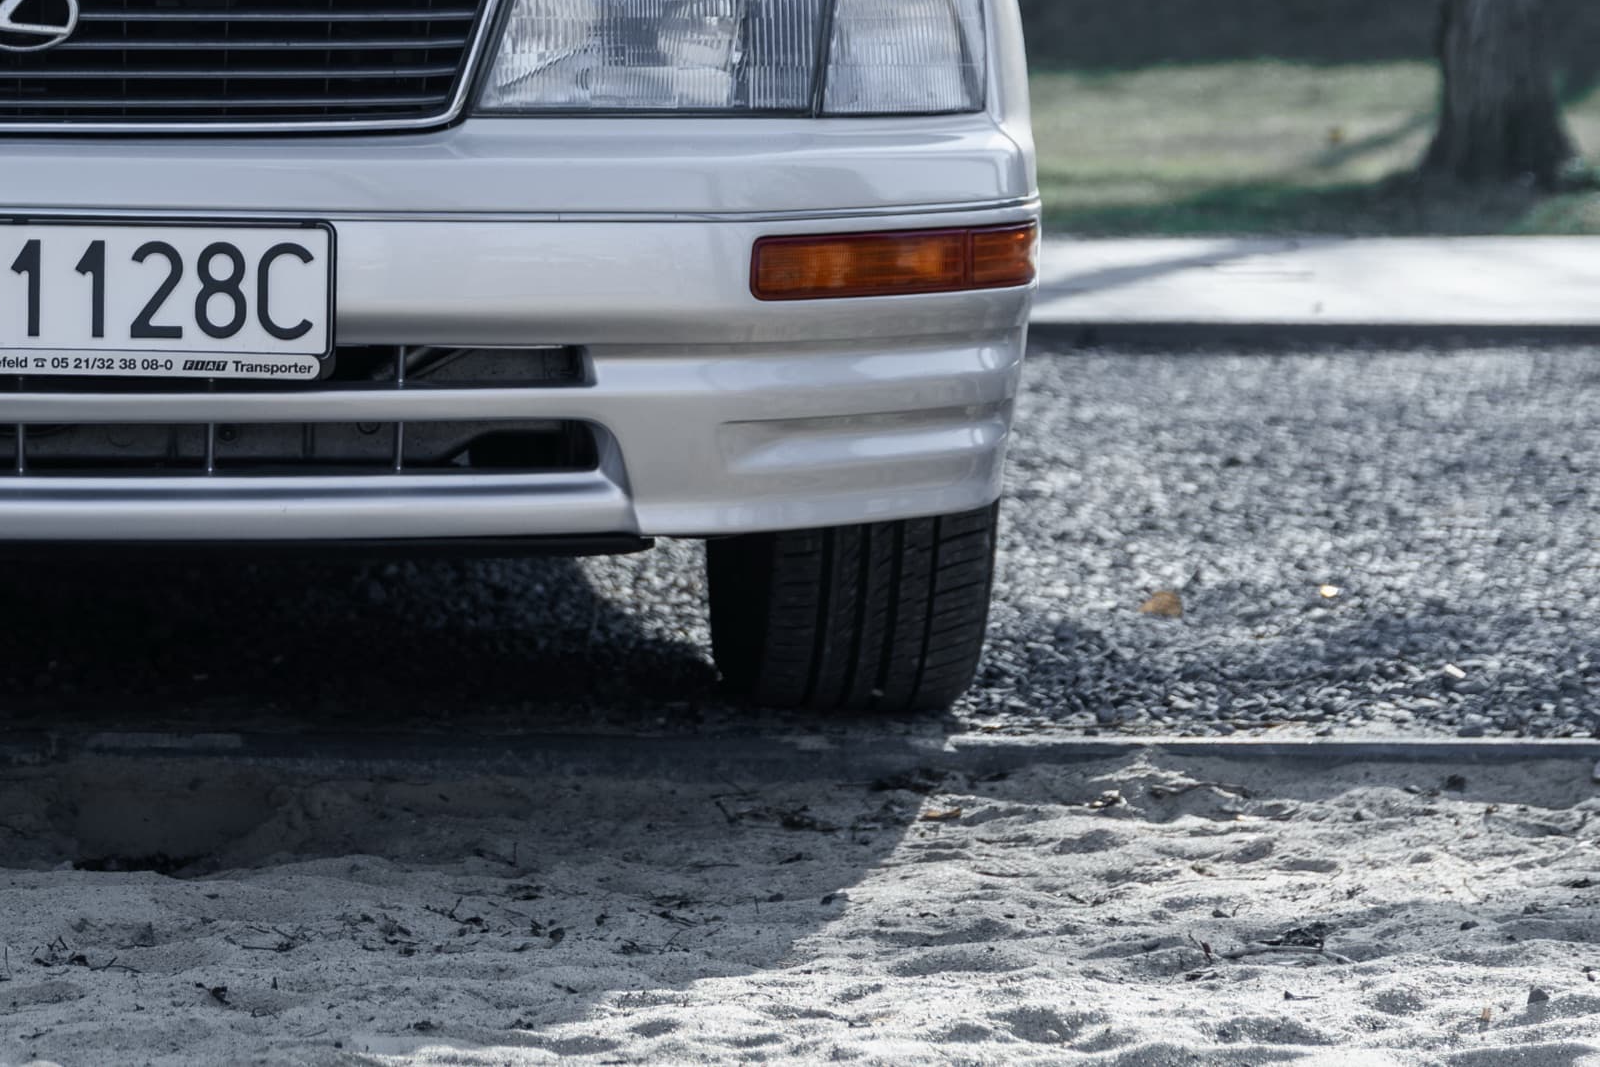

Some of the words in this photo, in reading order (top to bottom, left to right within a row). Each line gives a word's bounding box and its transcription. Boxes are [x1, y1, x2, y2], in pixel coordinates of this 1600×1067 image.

[10, 239, 315, 340] 1128C
[51, 357, 69, 369] 05
[73, 357, 115, 370] 21/32
[118, 358, 137, 370] 38
[141, 358, 174, 371] 08-0
[182, 359, 229, 372] FIAT
[232, 359, 314, 375] Transporter
